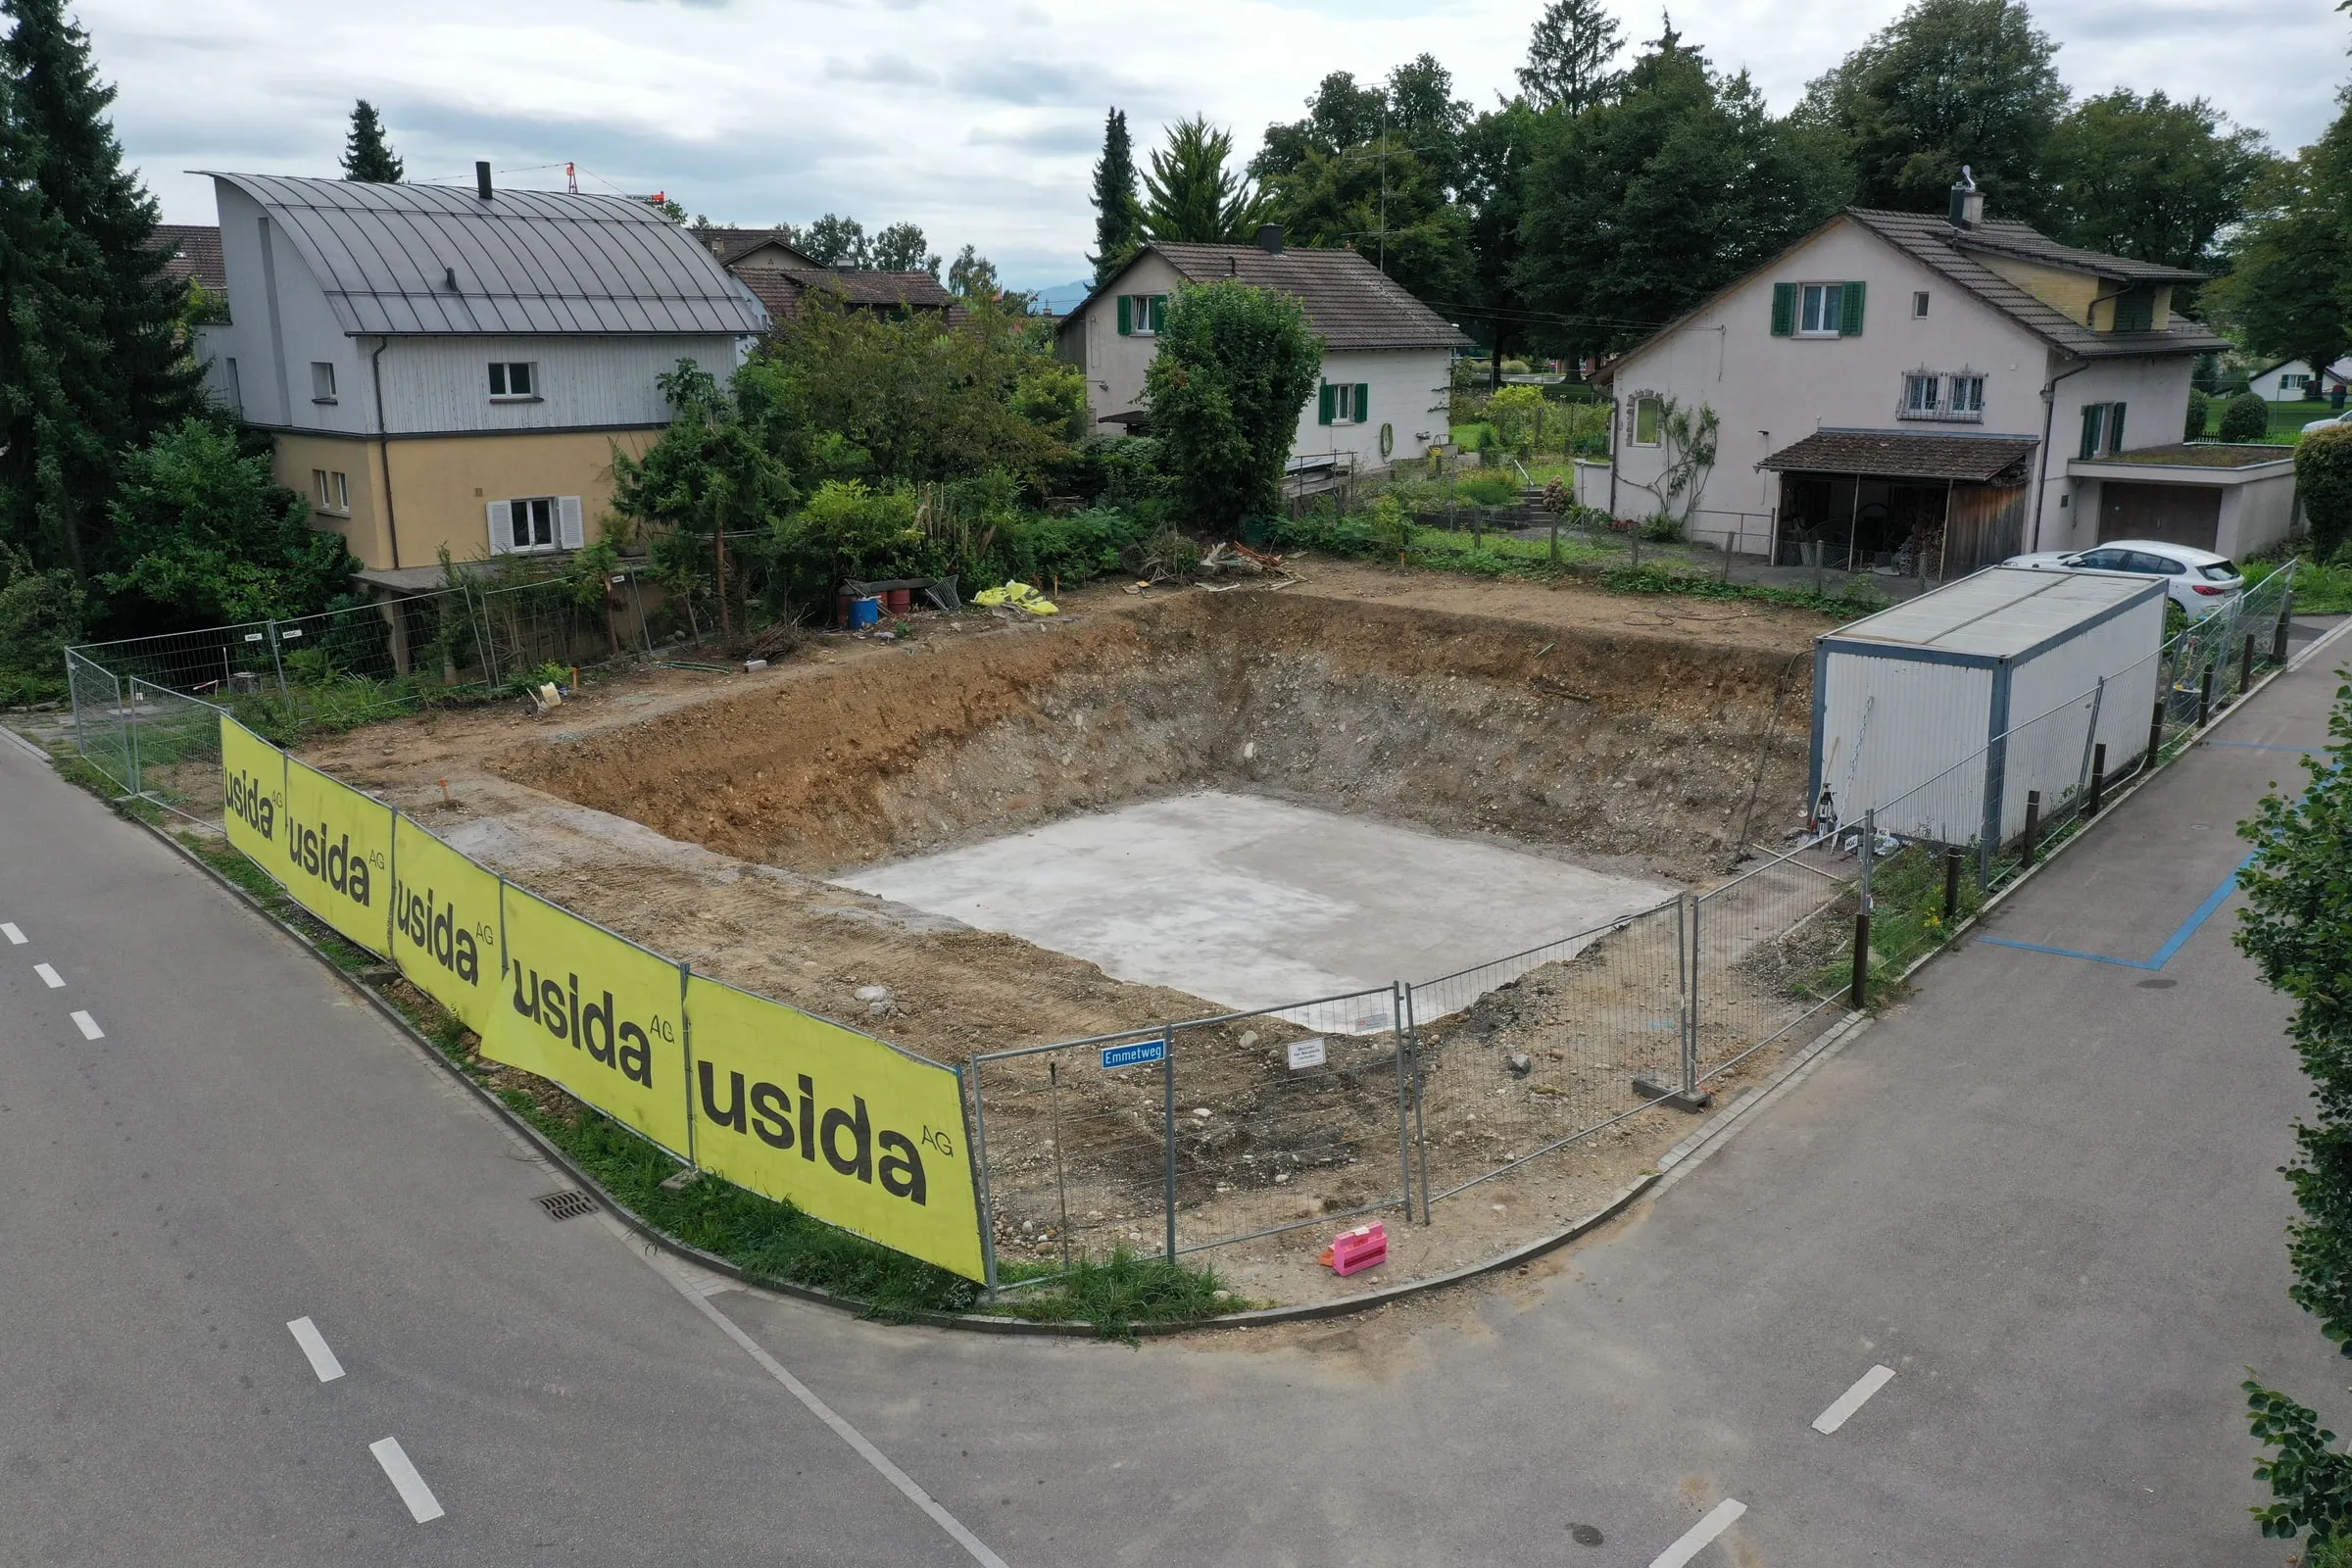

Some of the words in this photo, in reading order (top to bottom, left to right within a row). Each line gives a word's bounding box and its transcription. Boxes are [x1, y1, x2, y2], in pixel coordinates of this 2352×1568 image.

[224, 767, 273, 842] usida
[271, 790, 283, 808] AG
[289, 817, 369, 907] usida
[368, 849, 385, 871] AG
[397, 879, 479, 988] usida
[475, 921, 494, 947] AG
[513, 958, 653, 1090] usida
[650, 1014, 675, 1045] AG
[1104, 1047, 1161, 1064] Emmetweg
[698, 1059, 926, 1207] usida
[921, 1124, 954, 1157] AG
